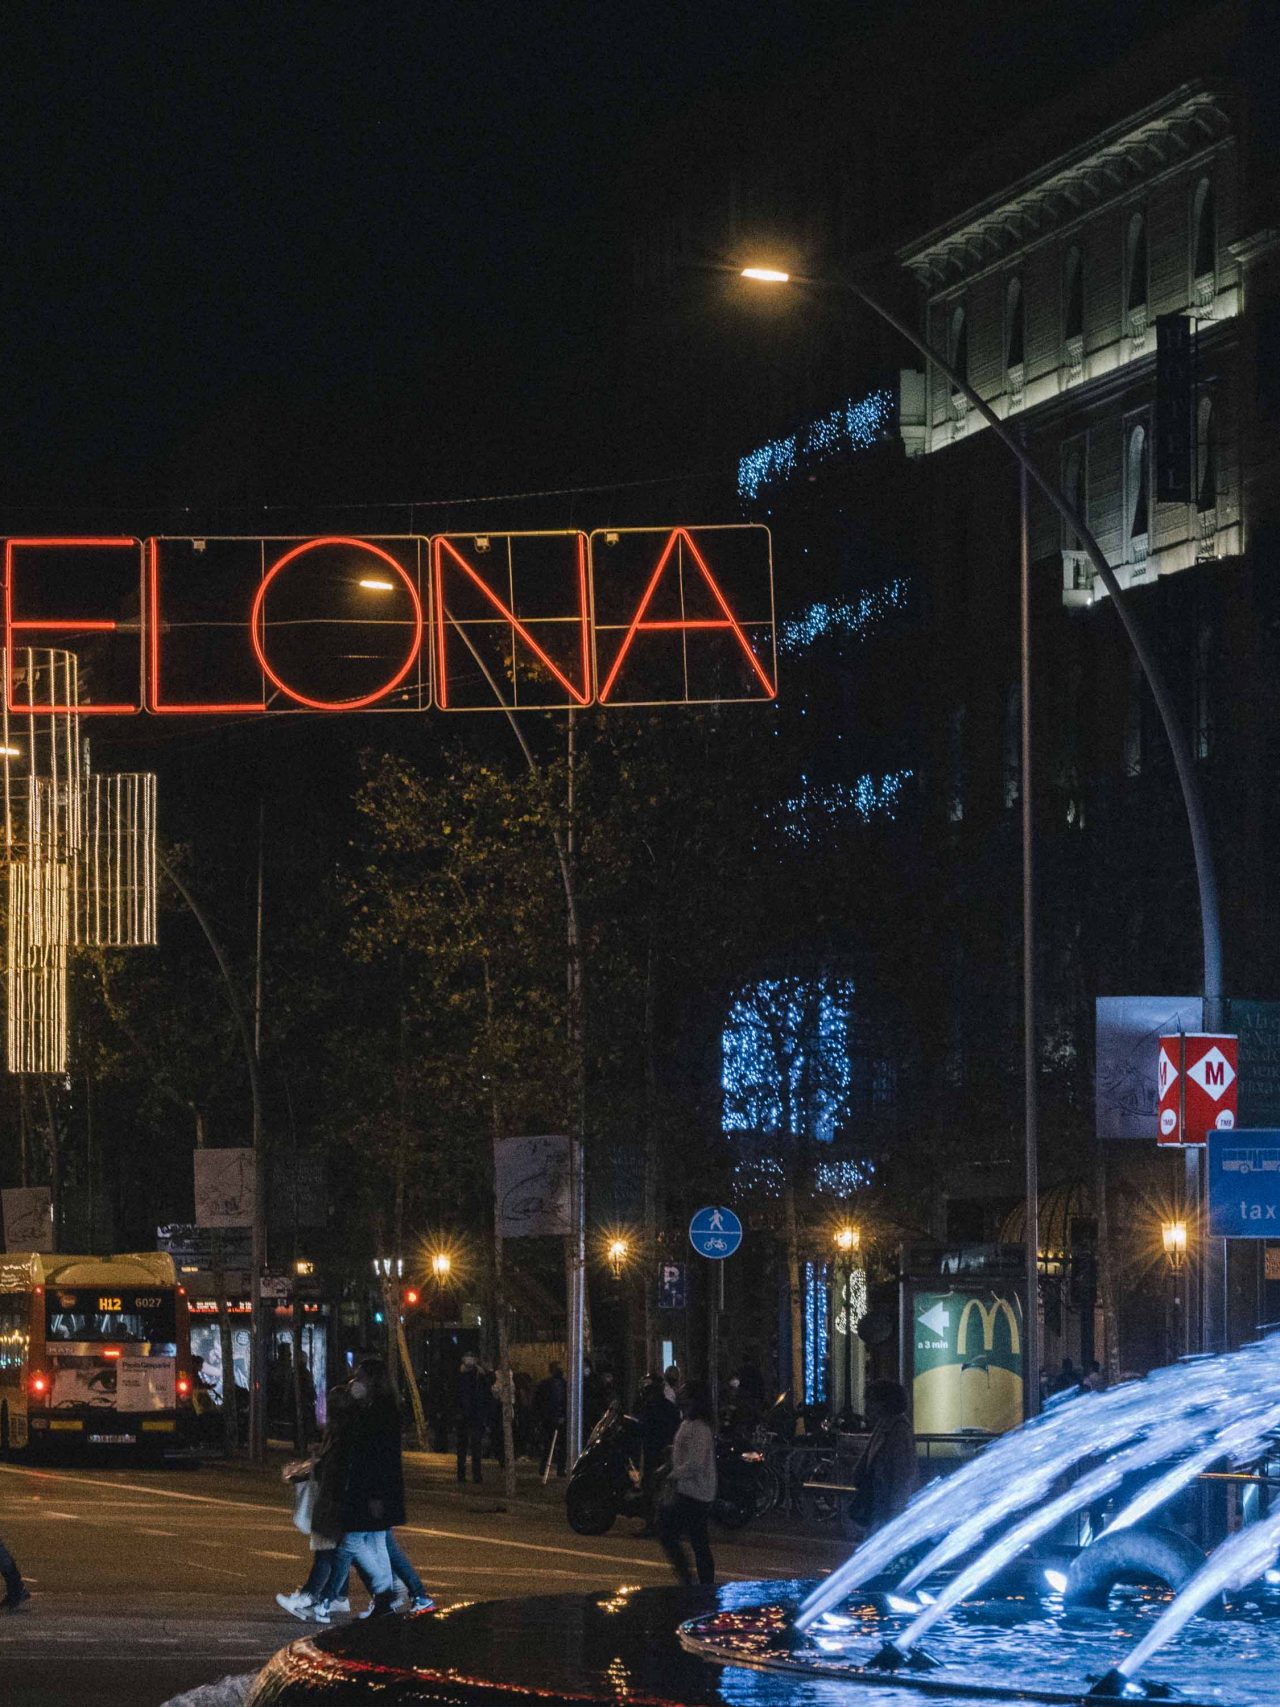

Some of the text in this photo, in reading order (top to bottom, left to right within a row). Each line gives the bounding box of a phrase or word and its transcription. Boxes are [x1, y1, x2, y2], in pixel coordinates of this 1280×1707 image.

[1205, 1061, 1224, 1086] M
[1220, 1118, 1232, 1127] TMB
[1240, 1200, 1276, 1220] tax
[663, 1265, 680, 1290] P
[98, 1297, 122, 1311] H12
[135, 1297, 162, 1308] 6027
[931, 1340, 949, 1349] min
